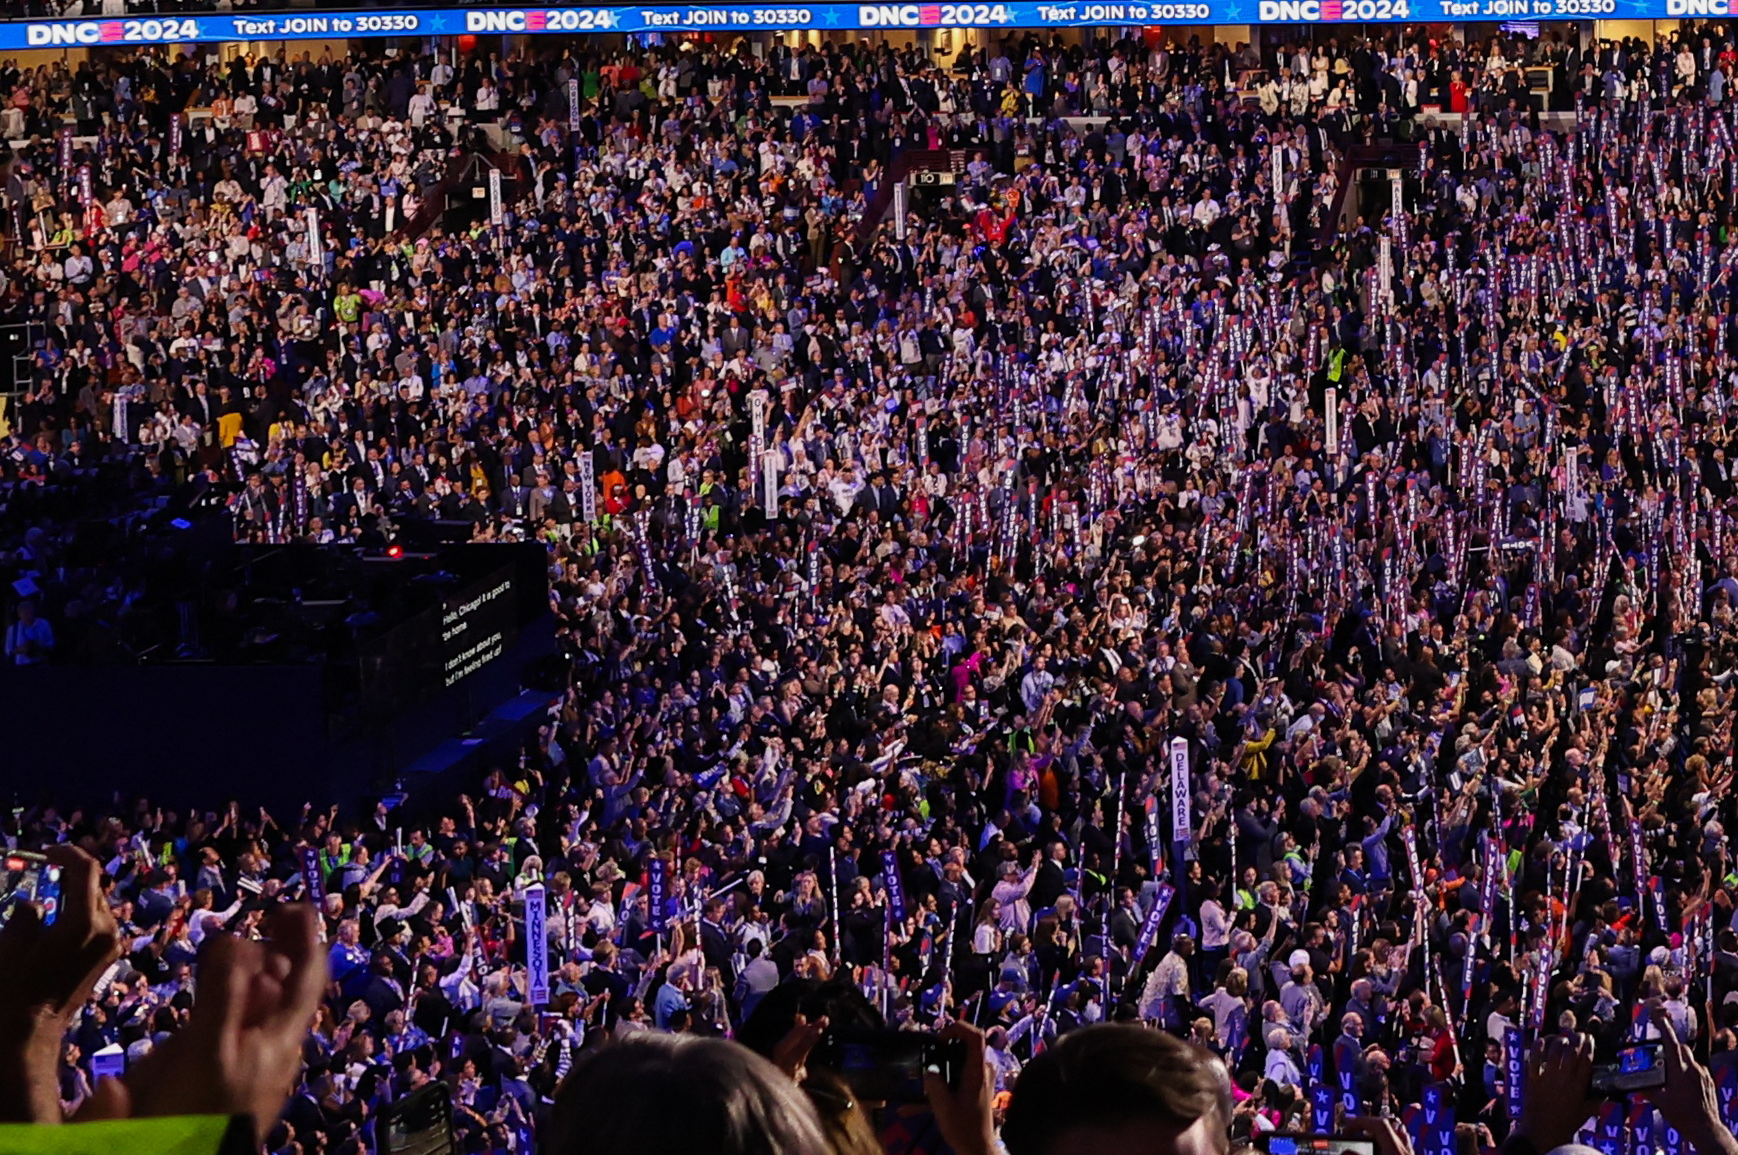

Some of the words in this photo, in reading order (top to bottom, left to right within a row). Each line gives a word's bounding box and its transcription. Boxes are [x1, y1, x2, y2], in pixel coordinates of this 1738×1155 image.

[124, 18, 200, 42] 2024
[233, 19, 276, 35] Text
[279, 17, 328, 34] JOIN
[331, 17, 352, 33] to
[356, 15, 418, 32] 30330
[546, 8, 614, 31] 2024
[641, 10, 680, 26] Text
[682, 10, 727, 26] JOIN
[730, 10, 750, 25] to
[753, 8, 811, 25] 30330
[940, 3, 1009, 26] 2024
[1037, 5, 1077, 21] Text
[1079, 4, 1125, 21] JOIN
[1128, 4, 1148, 20] to
[1151, 3, 1210, 20] 30330
[1439, 0, 1480, 16] Text
[1482, 0, 1529, 16] JOIN
[1532, 0, 1552, 16] to
[755, 398, 763, 446] OHIO
[584, 461, 592, 479] NEW
[585, 485, 593, 511] YORK
[810, 551, 818, 586] VOTE
[1175, 753, 1187, 827] DELAWARE
[1149, 812, 1158, 860] VOTE
[1633, 833, 1643, 878] VOTE
[886, 864, 901, 908] VOTE
[1410, 845, 1422, 891] VOTE
[1485, 854, 1495, 897] VOTE
[651, 872, 661, 917] VOTE
[530, 901, 544, 988] MINNESOTA
[1138, 898, 1167, 946] VOTE
[1465, 931, 1477, 984] VOTE
[1534, 962, 1548, 1009] VOTE
[1509, 1048, 1520, 1099] VOTE
